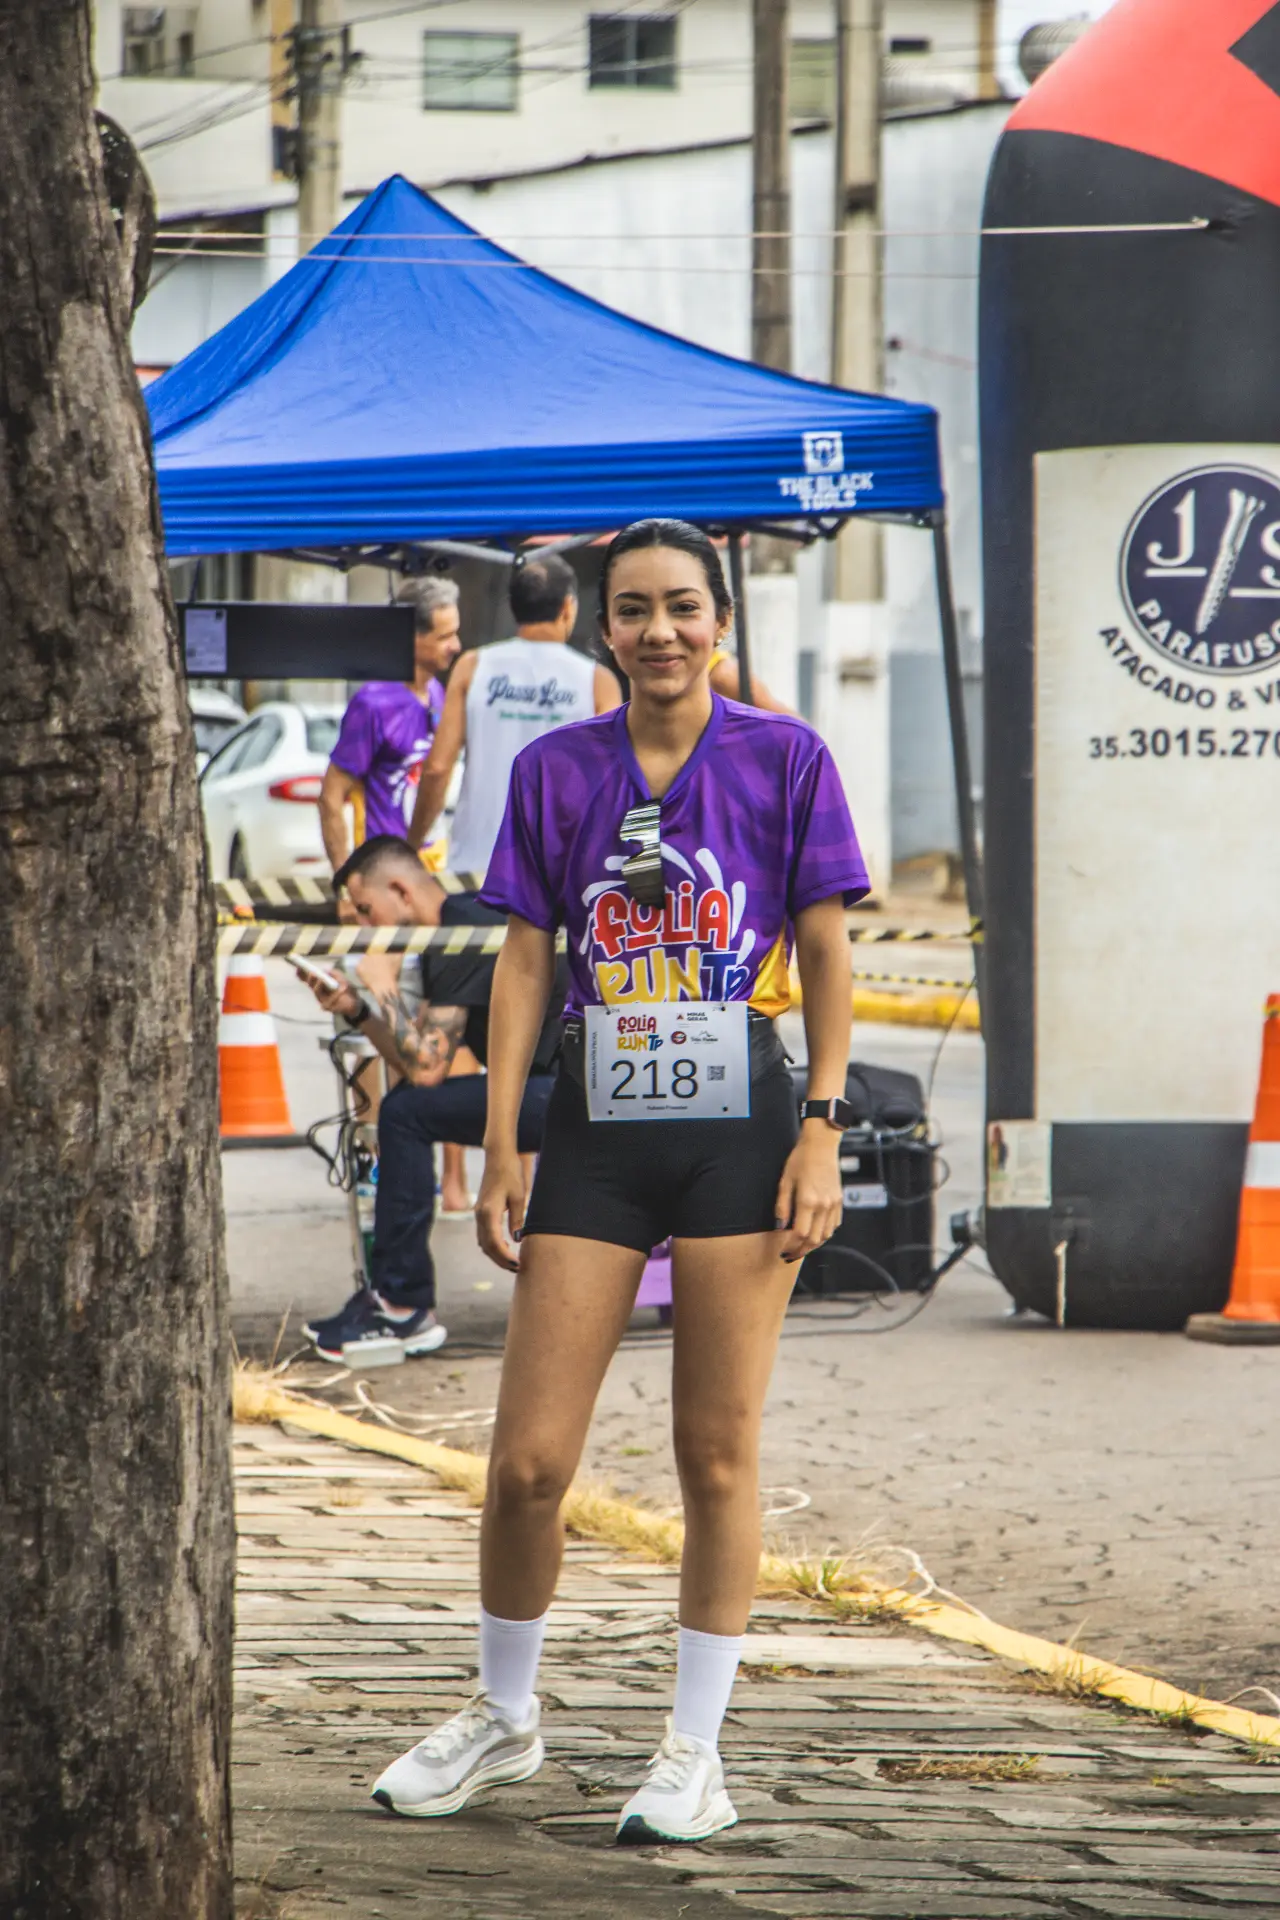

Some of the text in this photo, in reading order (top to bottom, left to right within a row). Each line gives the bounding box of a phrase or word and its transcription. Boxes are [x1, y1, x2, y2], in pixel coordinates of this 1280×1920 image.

[1099, 625, 1217, 710] ATACADO
[1226, 689, 1248, 712] &
[611, 1058, 699, 1100] 218
